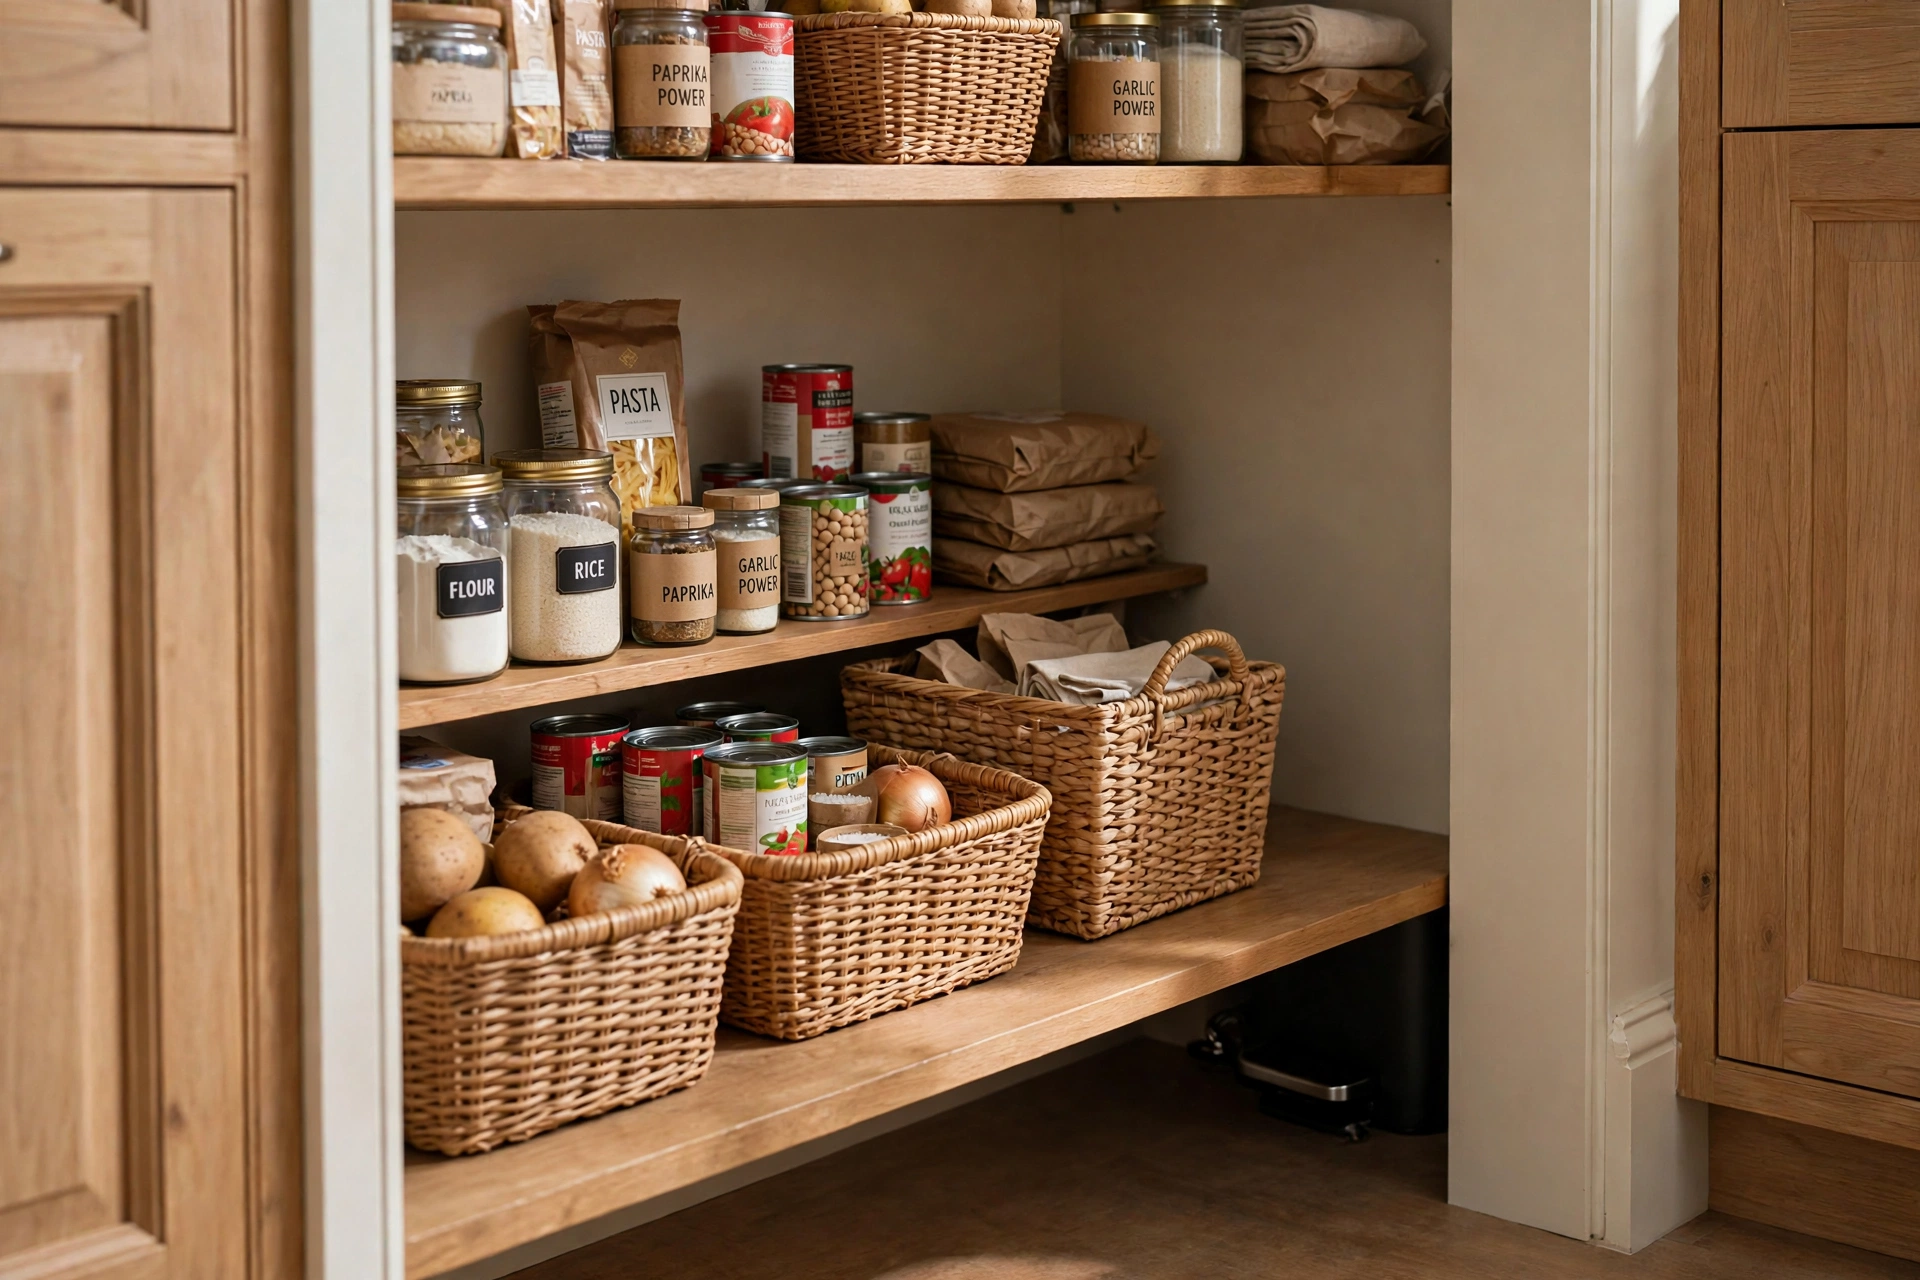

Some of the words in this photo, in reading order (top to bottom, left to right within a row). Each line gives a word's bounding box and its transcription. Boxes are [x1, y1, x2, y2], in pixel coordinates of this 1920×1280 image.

[652, 63, 708, 83] PAPRIKA
[1113, 79, 1155, 96] GARLIC
[658, 89, 706, 107] POWER
[1113, 100, 1155, 117] POWER
[610, 387, 661, 415] PASTA
[575, 559, 605, 580] RICE
[739, 554, 779, 573] GARLIC
[449, 578, 496, 600] FLOUR
[662, 582, 715, 603] PAPRIKA
[739, 575, 778, 595] POWER
